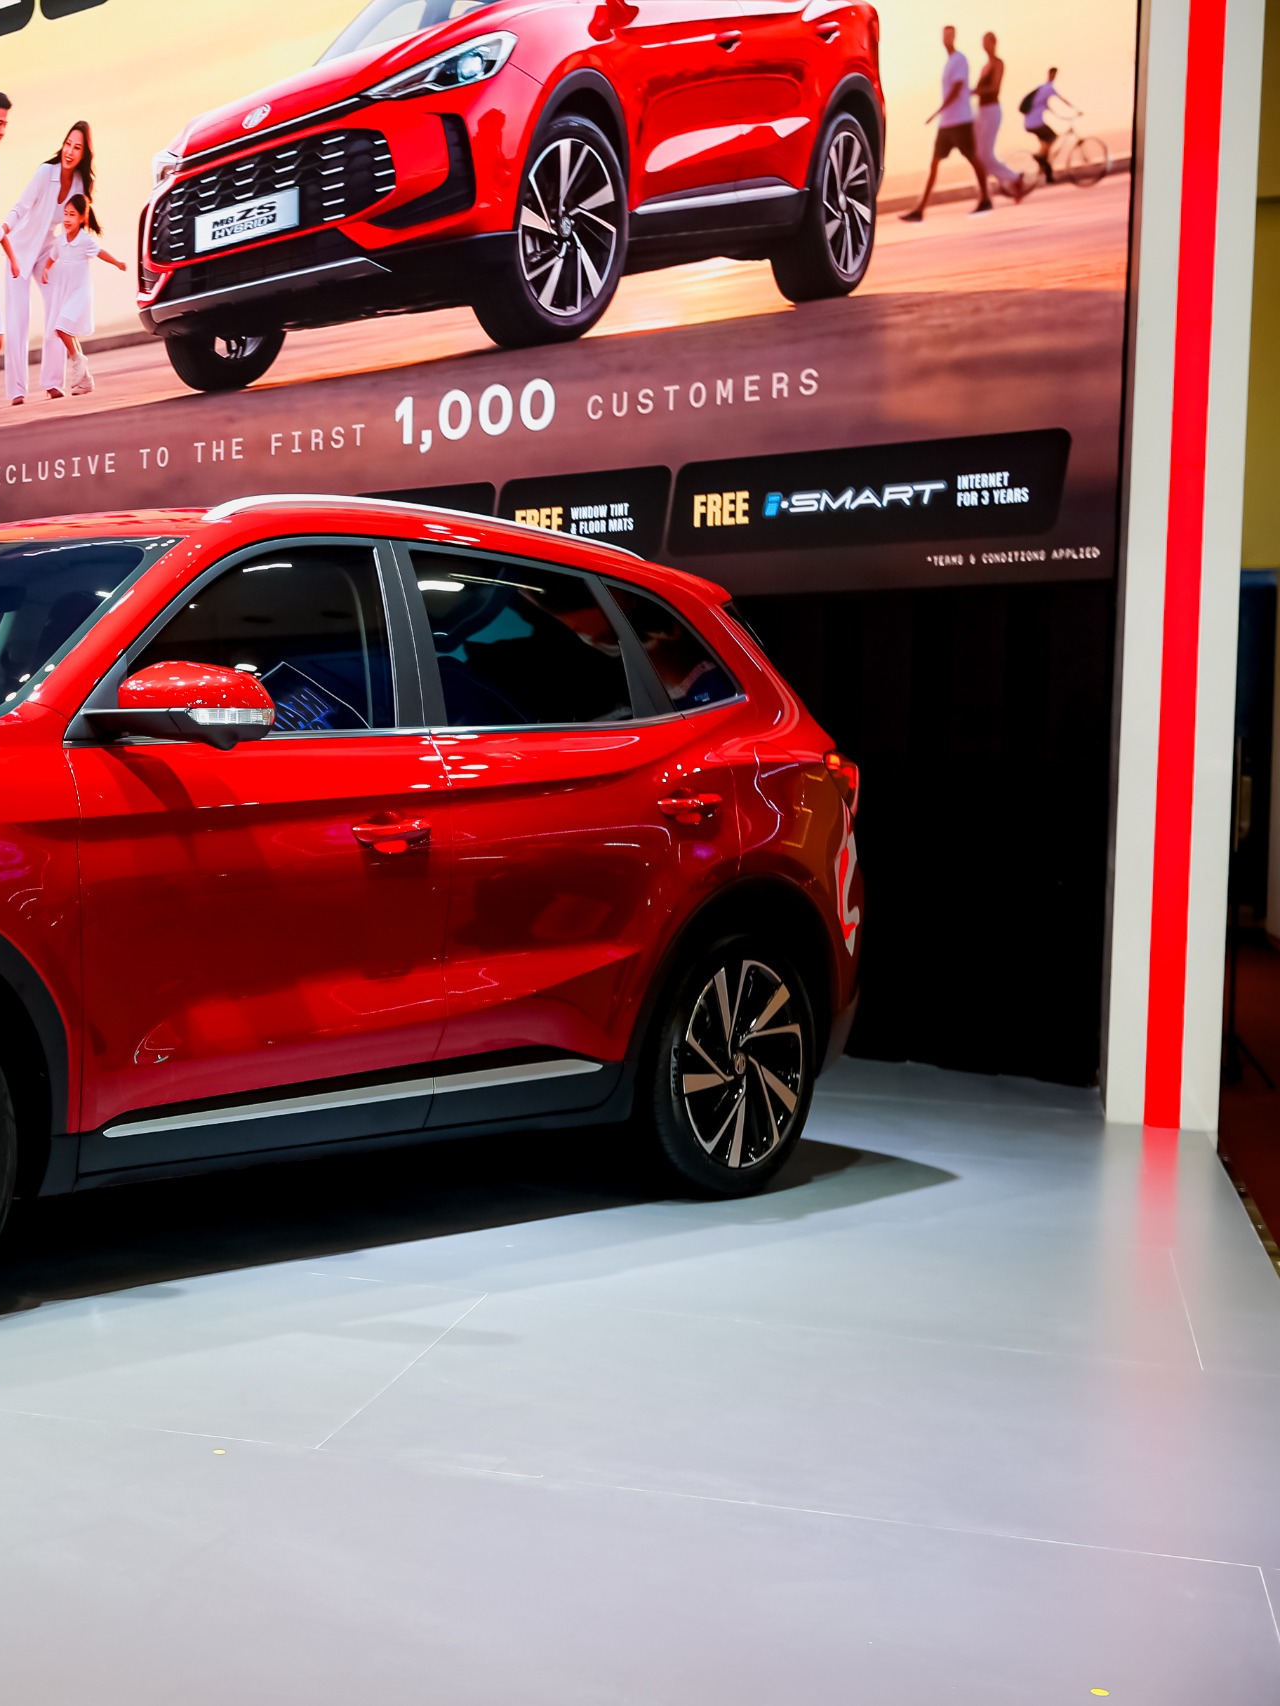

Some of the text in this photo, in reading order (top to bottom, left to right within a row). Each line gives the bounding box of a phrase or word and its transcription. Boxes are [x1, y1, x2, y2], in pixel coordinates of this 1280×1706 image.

[236, 201, 277, 222] ZS
[139, 446, 169, 469] TO
[193, 438, 244, 464] THE
[270, 424, 366, 456] FIRST
[394, 377, 556, 453] 1,000
[587, 368, 820, 420] CUSTOMERS
[693, 490, 749, 528] FREE
[957, 471, 1009, 490] INTERNET
[957, 487, 1030, 508] FOR 3 YEARS
[570, 504, 608, 520] WINDOW
[610, 502, 629, 517] TINT
[579, 520, 606, 534] FLOOR
[608, 517, 634, 532] MATS
[981, 549, 1047, 564] CONDITIONS
[1051, 546, 1101, 560] APPLIED
